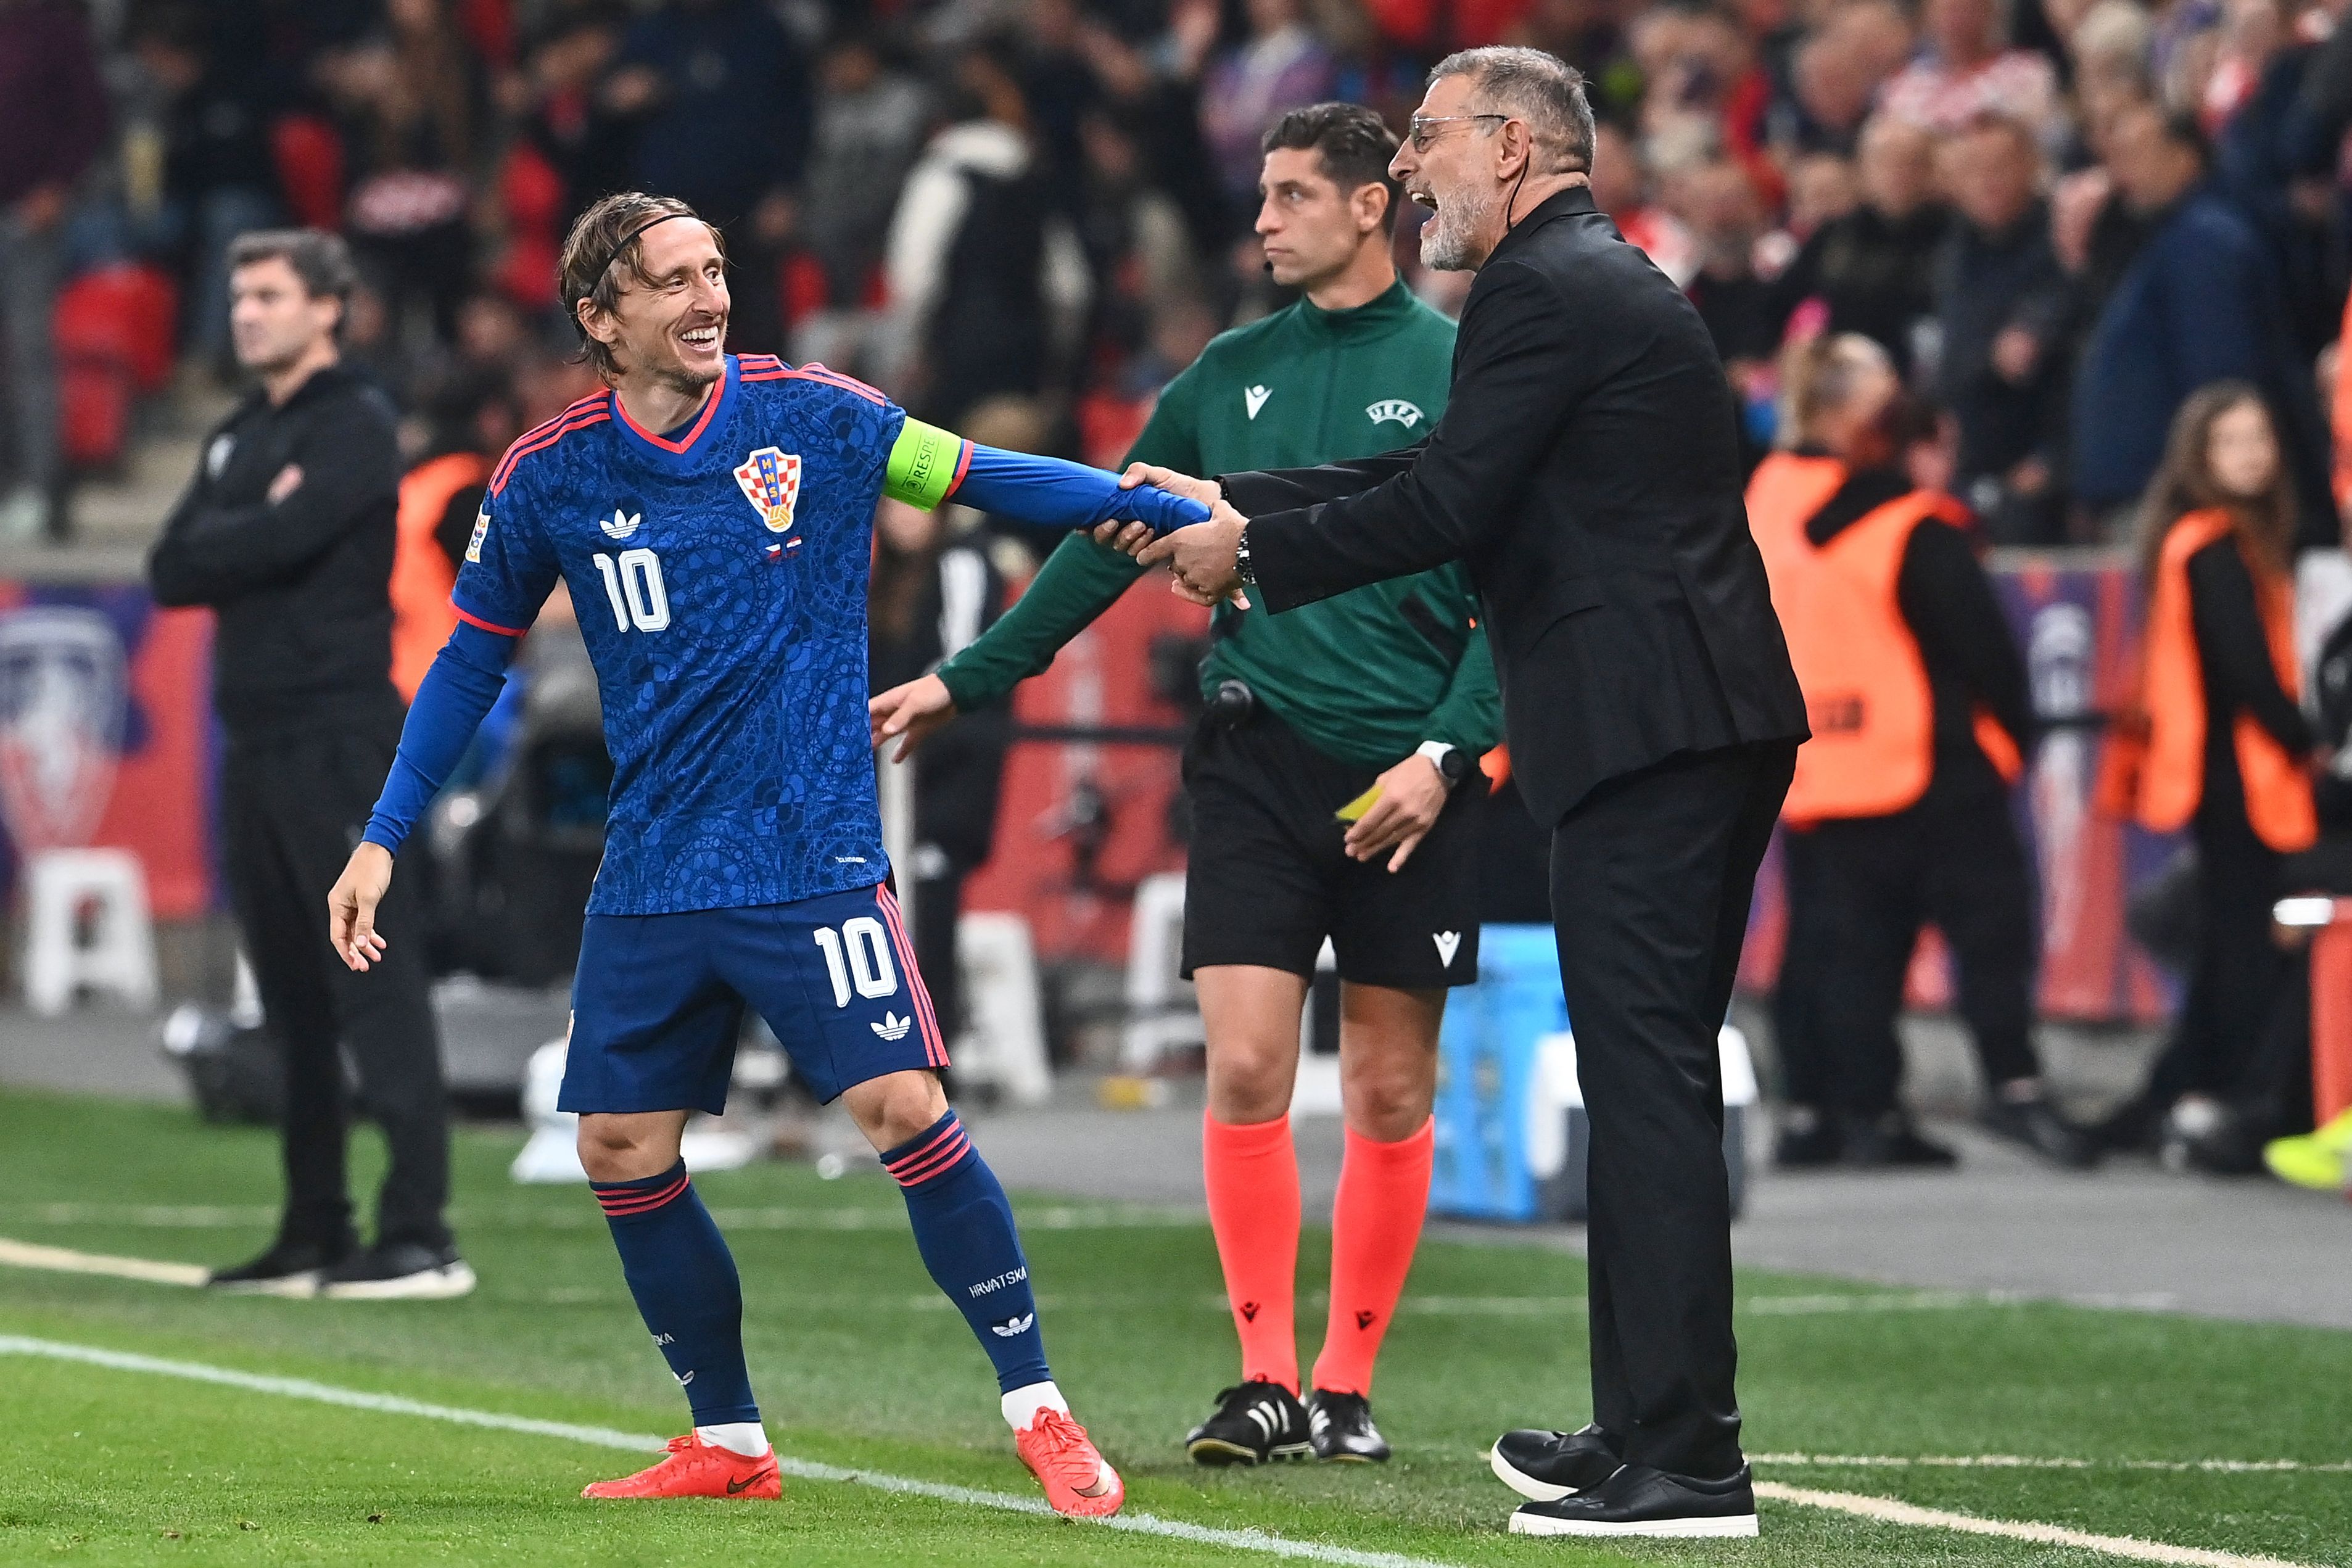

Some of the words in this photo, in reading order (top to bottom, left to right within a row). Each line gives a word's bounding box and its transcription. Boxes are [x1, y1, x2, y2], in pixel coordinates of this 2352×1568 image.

[1365, 399, 1424, 429] UEFA
[593, 548, 671, 633] 10
[813, 917, 897, 1008] 10
[968, 1265, 1028, 1298] HRVATSKA
